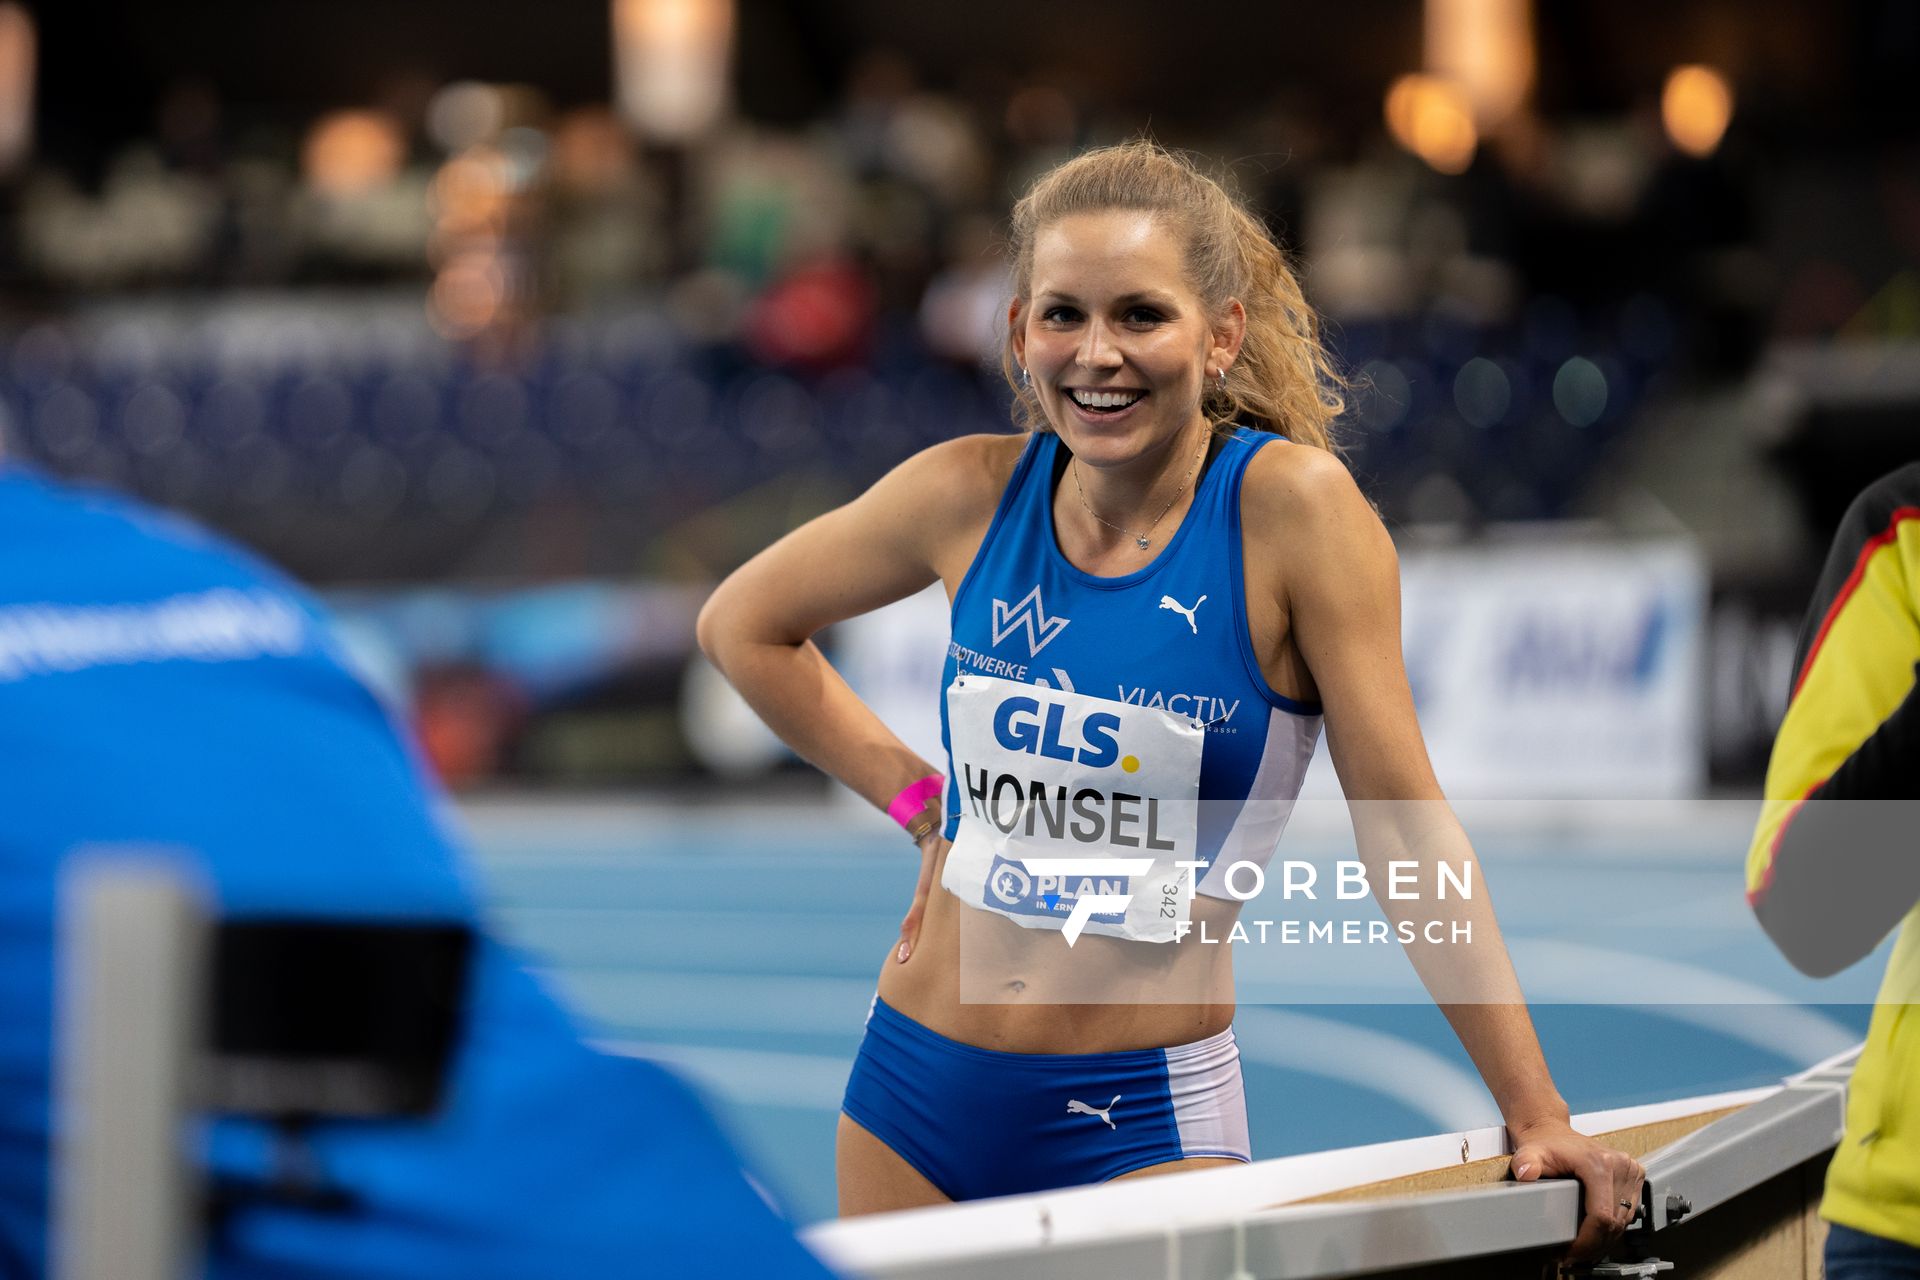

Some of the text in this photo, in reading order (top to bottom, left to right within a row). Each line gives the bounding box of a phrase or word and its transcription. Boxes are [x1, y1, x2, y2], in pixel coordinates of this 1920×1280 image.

[949, 641, 1028, 681] STADTWERKE
[1118, 685, 1240, 722] VIACTIV
[1206, 724, 1238, 735] kasse
[965, 763, 1175, 851] HONSEL
[1037, 874, 1121, 900] PLAN
[1160, 884, 1178, 919] 342
